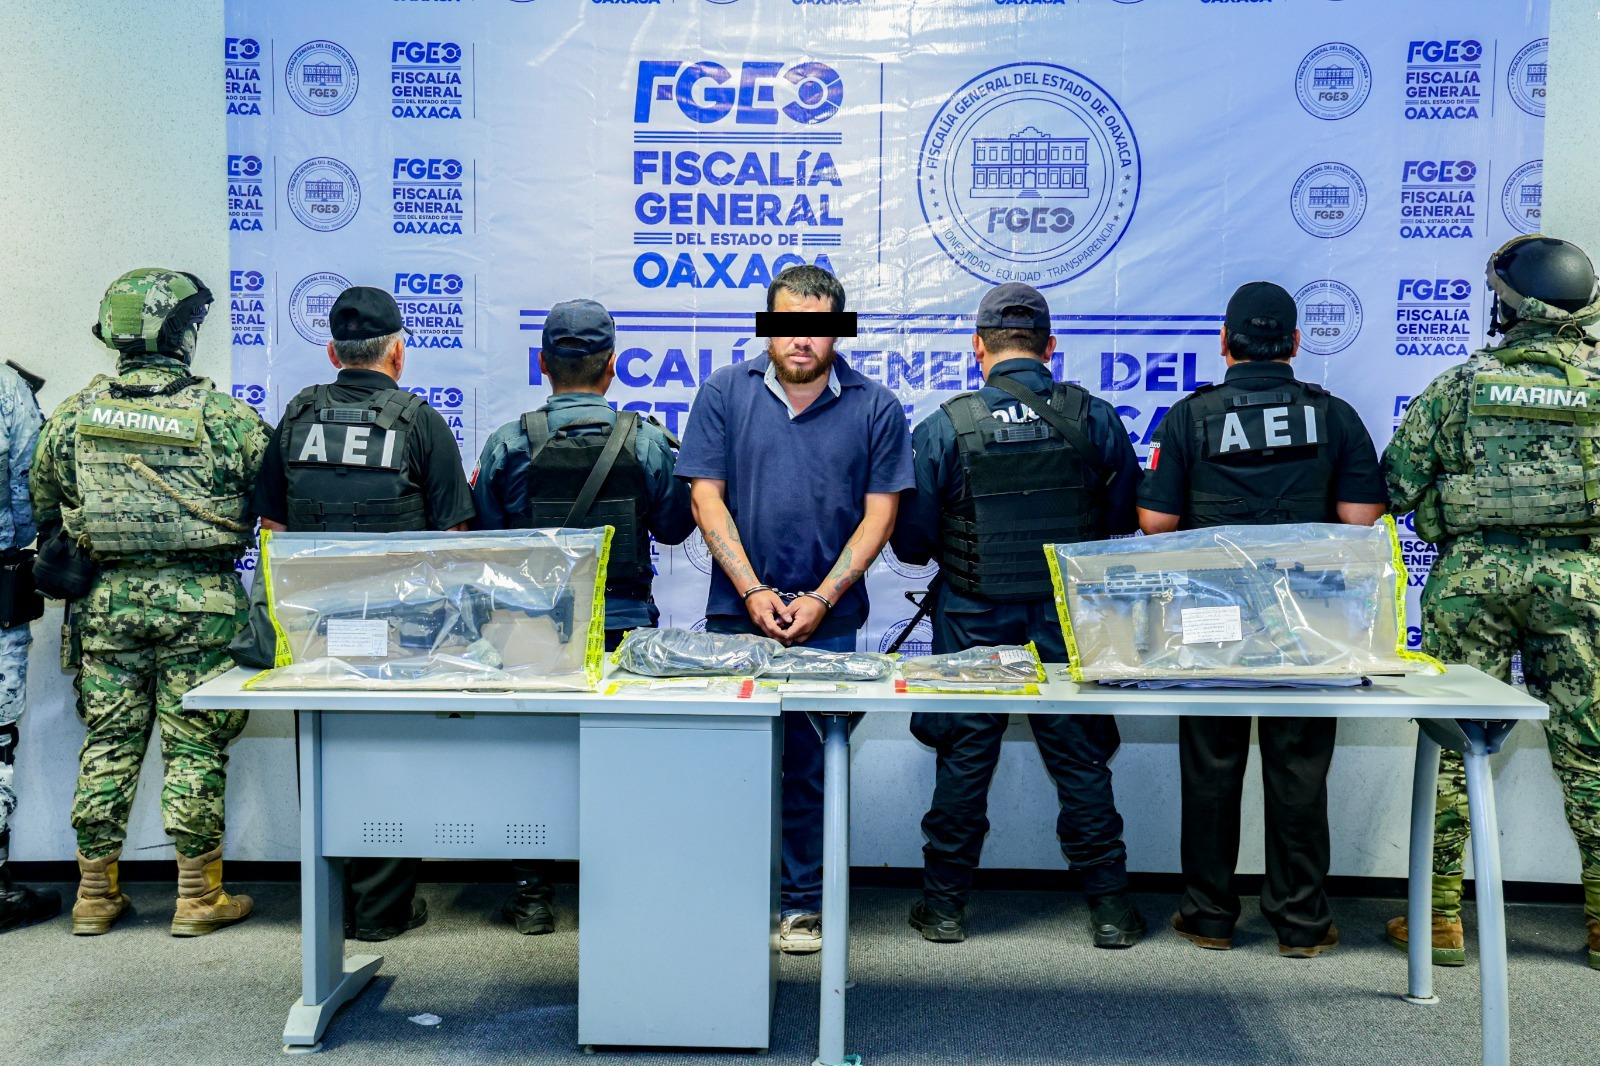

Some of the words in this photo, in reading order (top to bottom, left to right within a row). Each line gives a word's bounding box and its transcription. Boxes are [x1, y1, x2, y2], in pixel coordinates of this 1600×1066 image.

[226, 68, 260, 80] ALÍA
[392, 71, 461, 85] FISCALÍA
[1406, 71, 1480, 84] FISCALÍA
[392, 86, 462, 97] GENERAL
[1406, 86, 1480, 97] GENERAL
[227, 102, 261, 115] ACA
[392, 105, 461, 119] OAXACA
[1405, 107, 1478, 119] OAXACA
[927, 110, 958, 170] FISCALÍA
[952, 74, 1011, 115] GENERAL
[1013, 72, 1039, 84] DEL
[1041, 73, 1092, 103] ESTADO
[1088, 96, 1110, 118] DE
[1102, 114, 1131, 169] OAXACA
[634, 150, 842, 186] FISCALÍA
[229, 185, 262, 197] ALÍA
[393, 187, 462, 201] FISCALÍA
[1401, 191, 1475, 203] FISCALÍA
[394, 202, 463, 214] GENERAL
[635, 192, 843, 226] GENERAL
[1401, 206, 1475, 217] GENERAL
[230, 219, 263, 231] ACA
[394, 221, 462, 235] OAXACA
[1400, 225, 1473, 239] OAXACA
[676, 233, 705, 245] DEL
[711, 233, 772, 245] ESTADO
[778, 234, 798, 246] DE
[996, 269, 1041, 282] EQUIDAD
[1046, 222, 1115, 278] TRANSPARENCIA
[301, 276, 320, 289] GENERAL
[329, 276, 345, 286] ESTADO
[1329, 284, 1346, 294] ESTADO
[231, 300, 264, 312] ALÍA
[1397, 309, 1470, 322] FISCALÍA
[1397, 323, 1470, 335] GENERAL
[232, 333, 264, 345] ACA
[1396, 344, 1468, 356] OAXACA
[840, 350, 1081, 391] ENEL
[1101, 352, 1212, 391] DEL
[1490, 386, 1587, 408] MARINA
[92, 408, 180, 434] MARINA
[1400, 541, 1439, 553] ISCA
